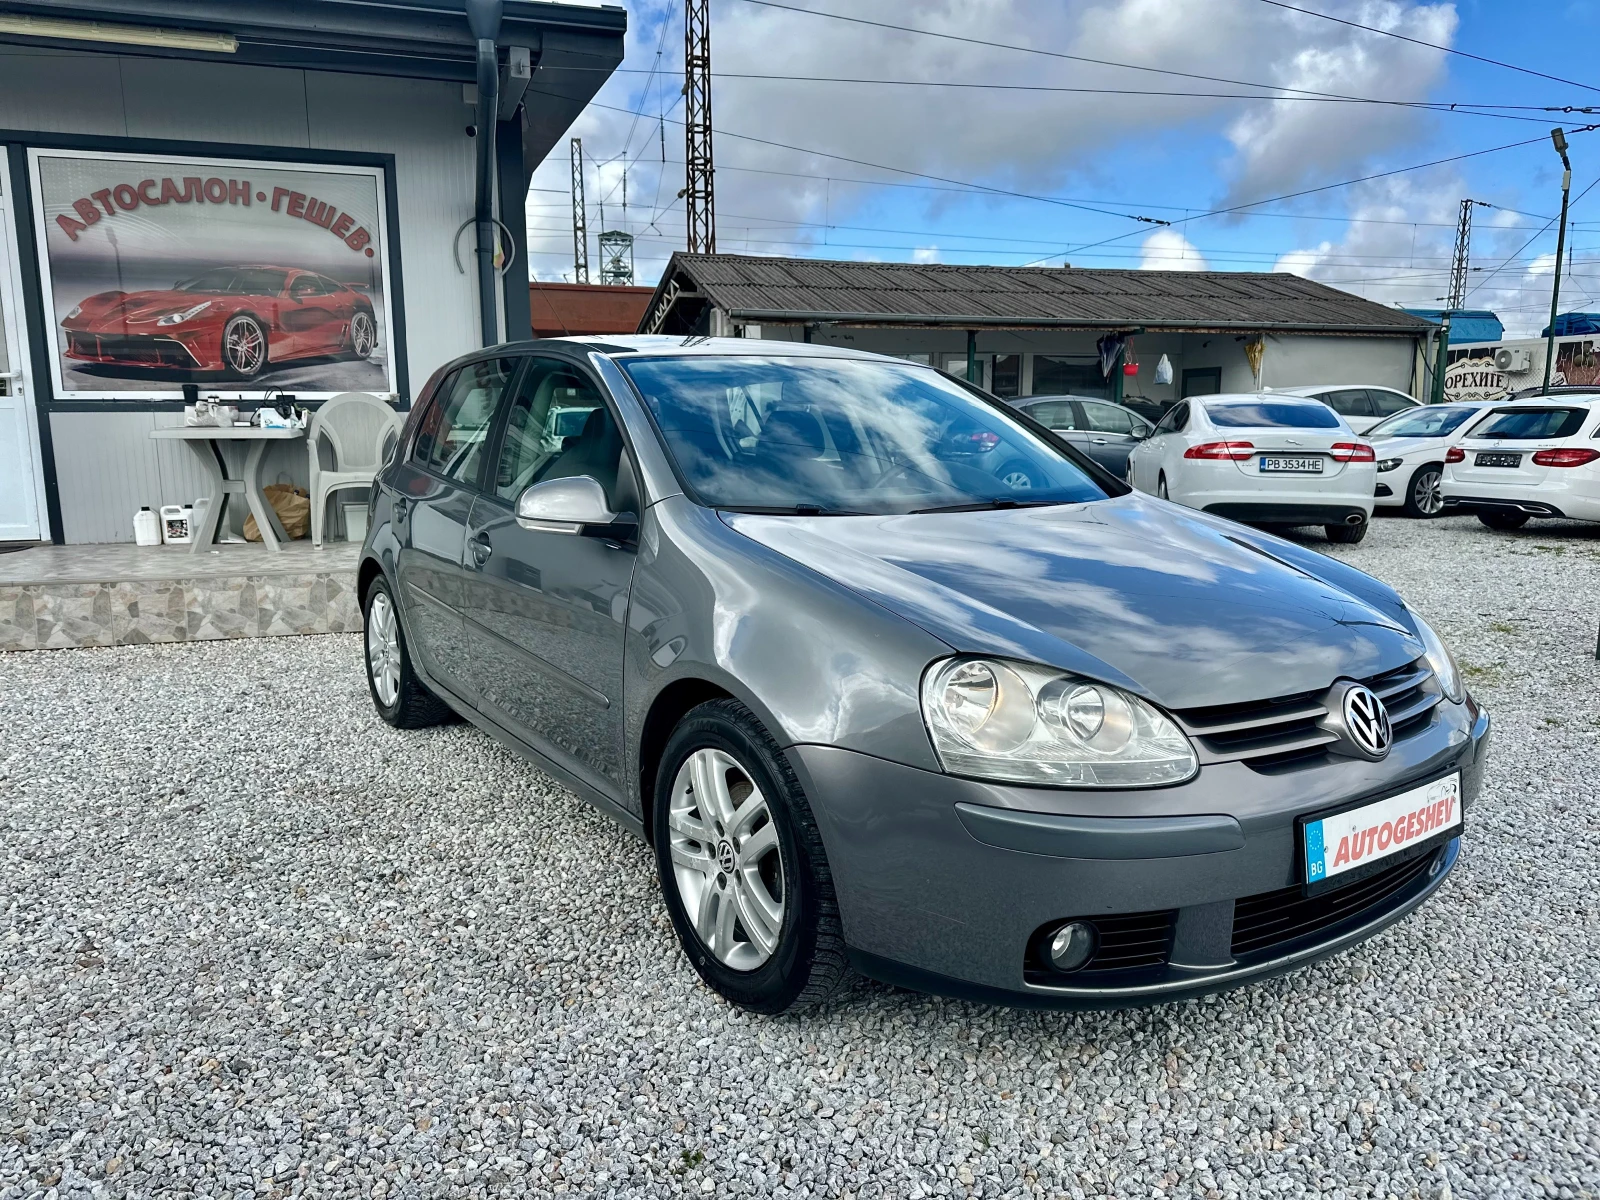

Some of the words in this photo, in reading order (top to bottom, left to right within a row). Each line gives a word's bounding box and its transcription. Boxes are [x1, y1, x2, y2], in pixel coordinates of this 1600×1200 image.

[55, 177, 250, 241] АВТОСАЛОН
[271, 186, 371, 250] ГЕШЕВ
[1445, 371, 1504, 389] ОРЕХИТЕ
[1267, 459, 1280, 469] PB
[1282, 459, 1306, 469] 3534
[1308, 460, 1321, 470] HE
[1333, 796, 1455, 867] AUTOGESHEV
[1311, 861, 1323, 876] BG
